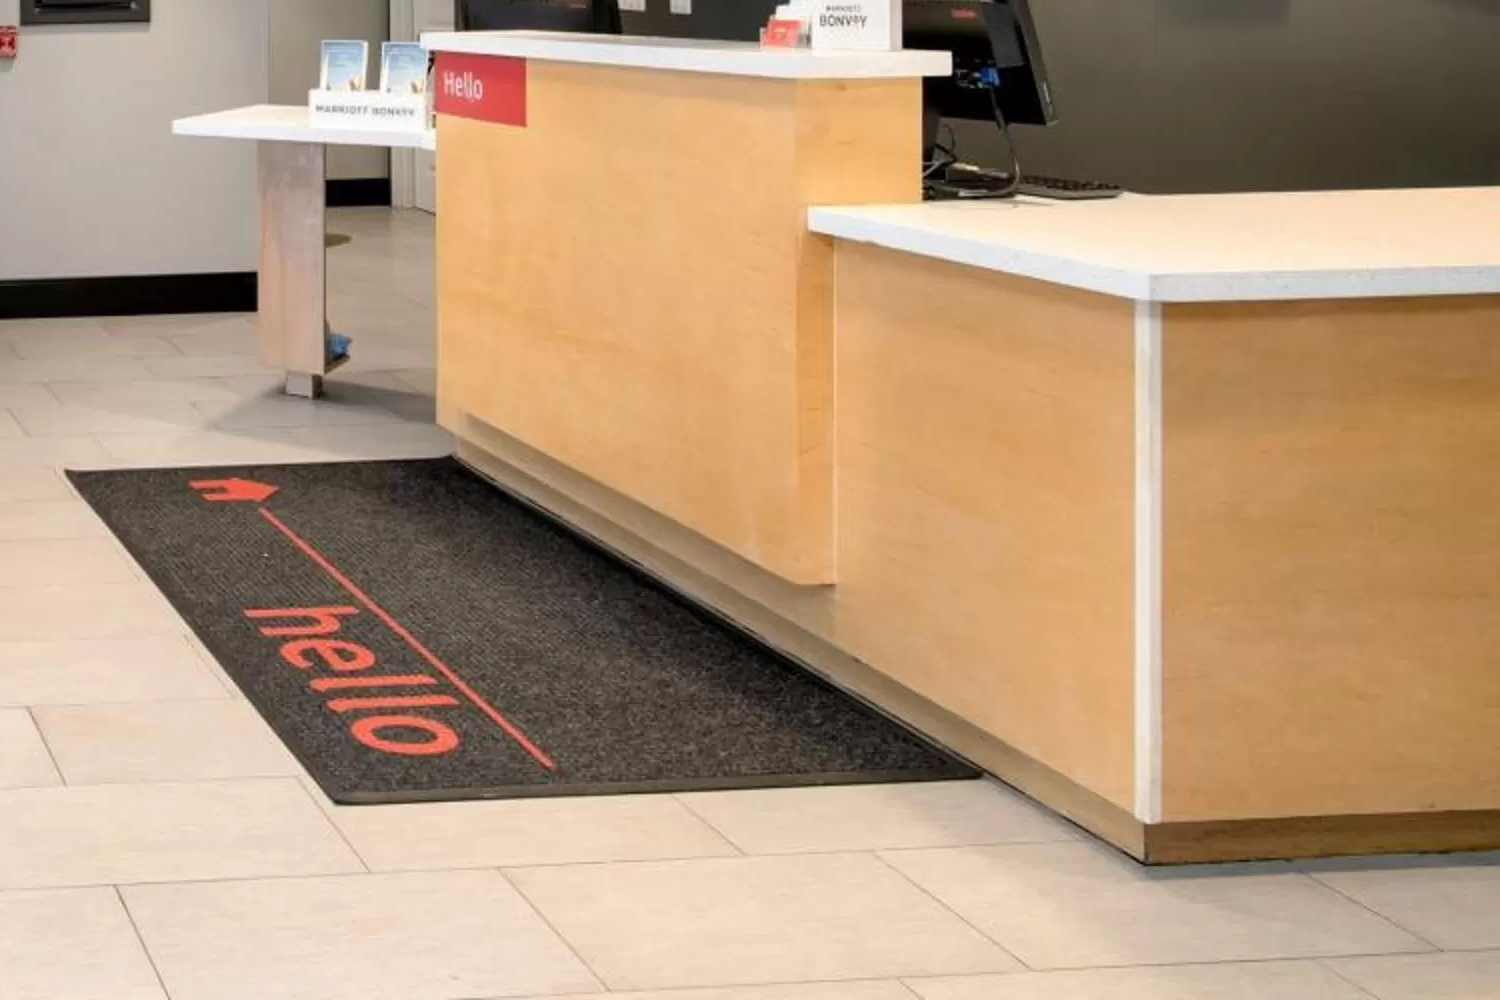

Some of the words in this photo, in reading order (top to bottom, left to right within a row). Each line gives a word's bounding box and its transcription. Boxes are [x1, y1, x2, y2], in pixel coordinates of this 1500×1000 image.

[443, 71, 484, 101] Hello
[316, 104, 368, 116] MARRIOTT
[244, 605, 460, 756] hello
